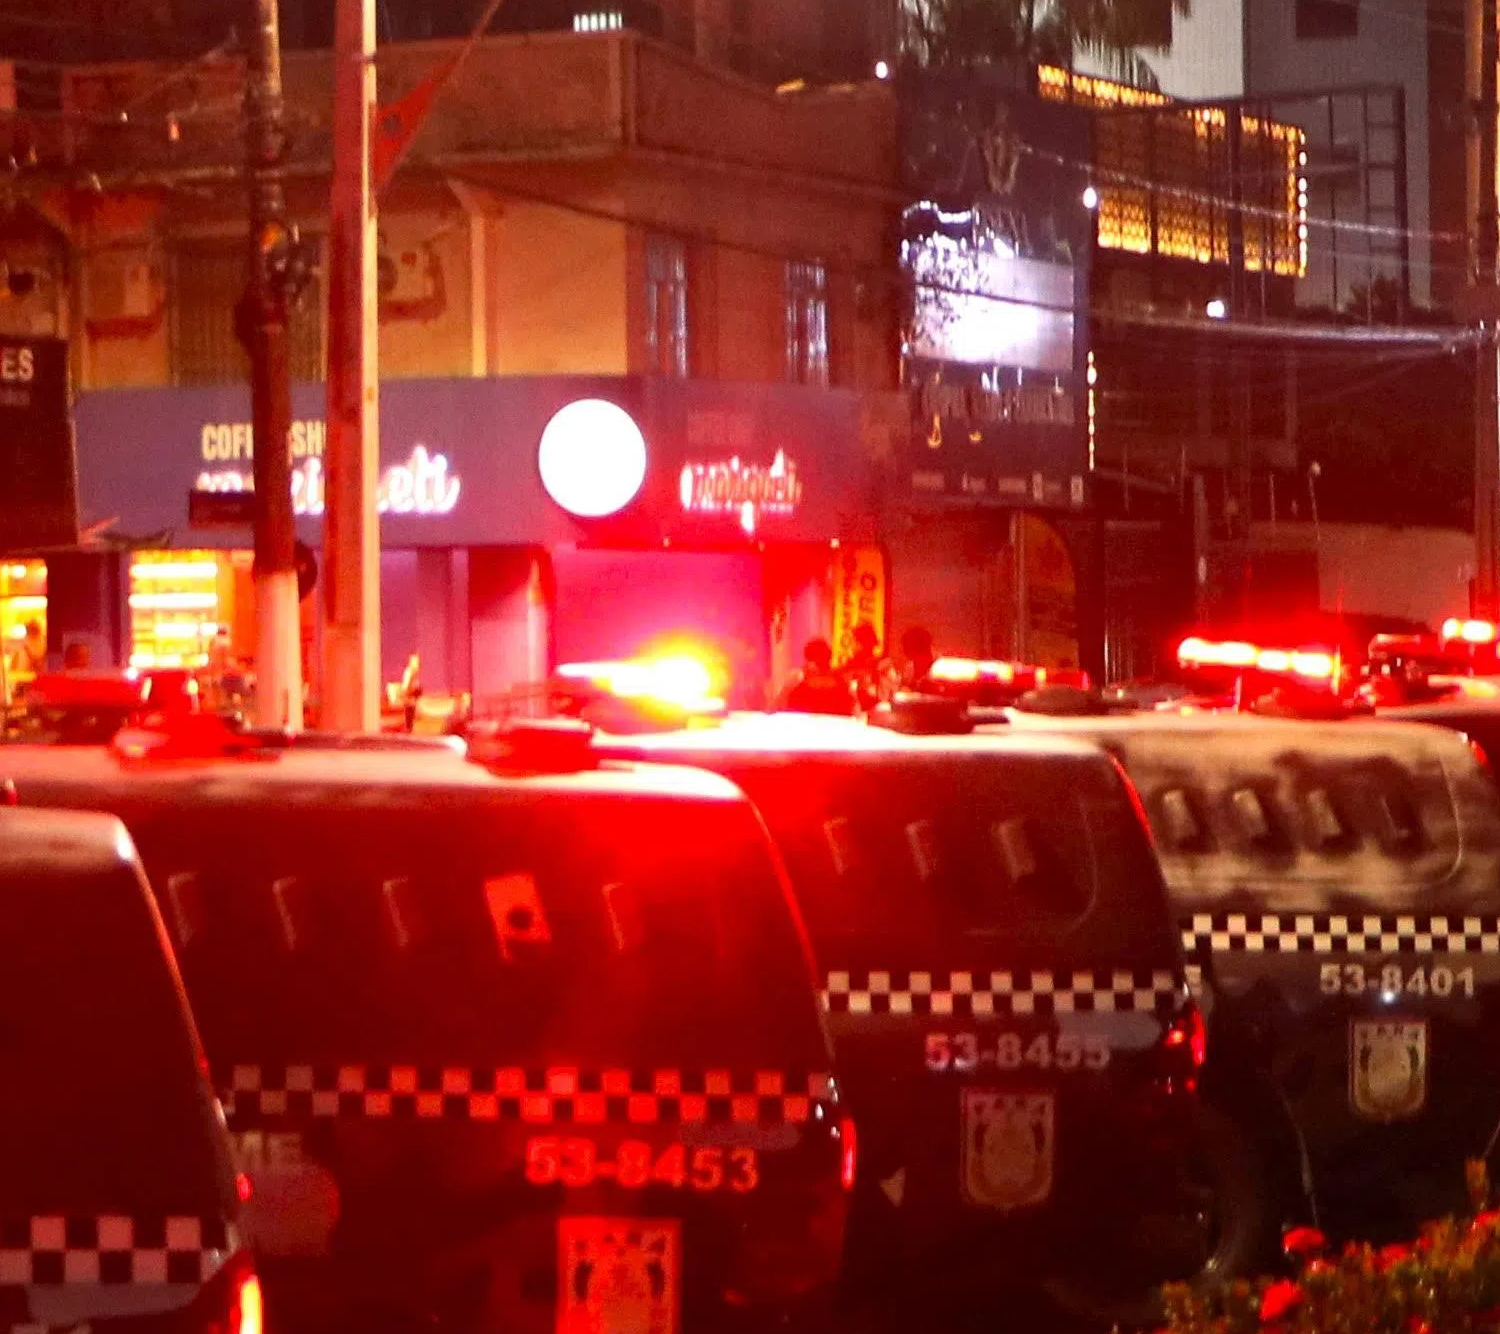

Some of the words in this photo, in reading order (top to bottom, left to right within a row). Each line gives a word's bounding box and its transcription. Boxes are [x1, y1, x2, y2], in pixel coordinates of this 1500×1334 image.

[1319, 962, 1475, 999] 53-8401
[924, 1031, 1112, 1074] 53-8455
[526, 1135, 760, 1193] 53-8453
